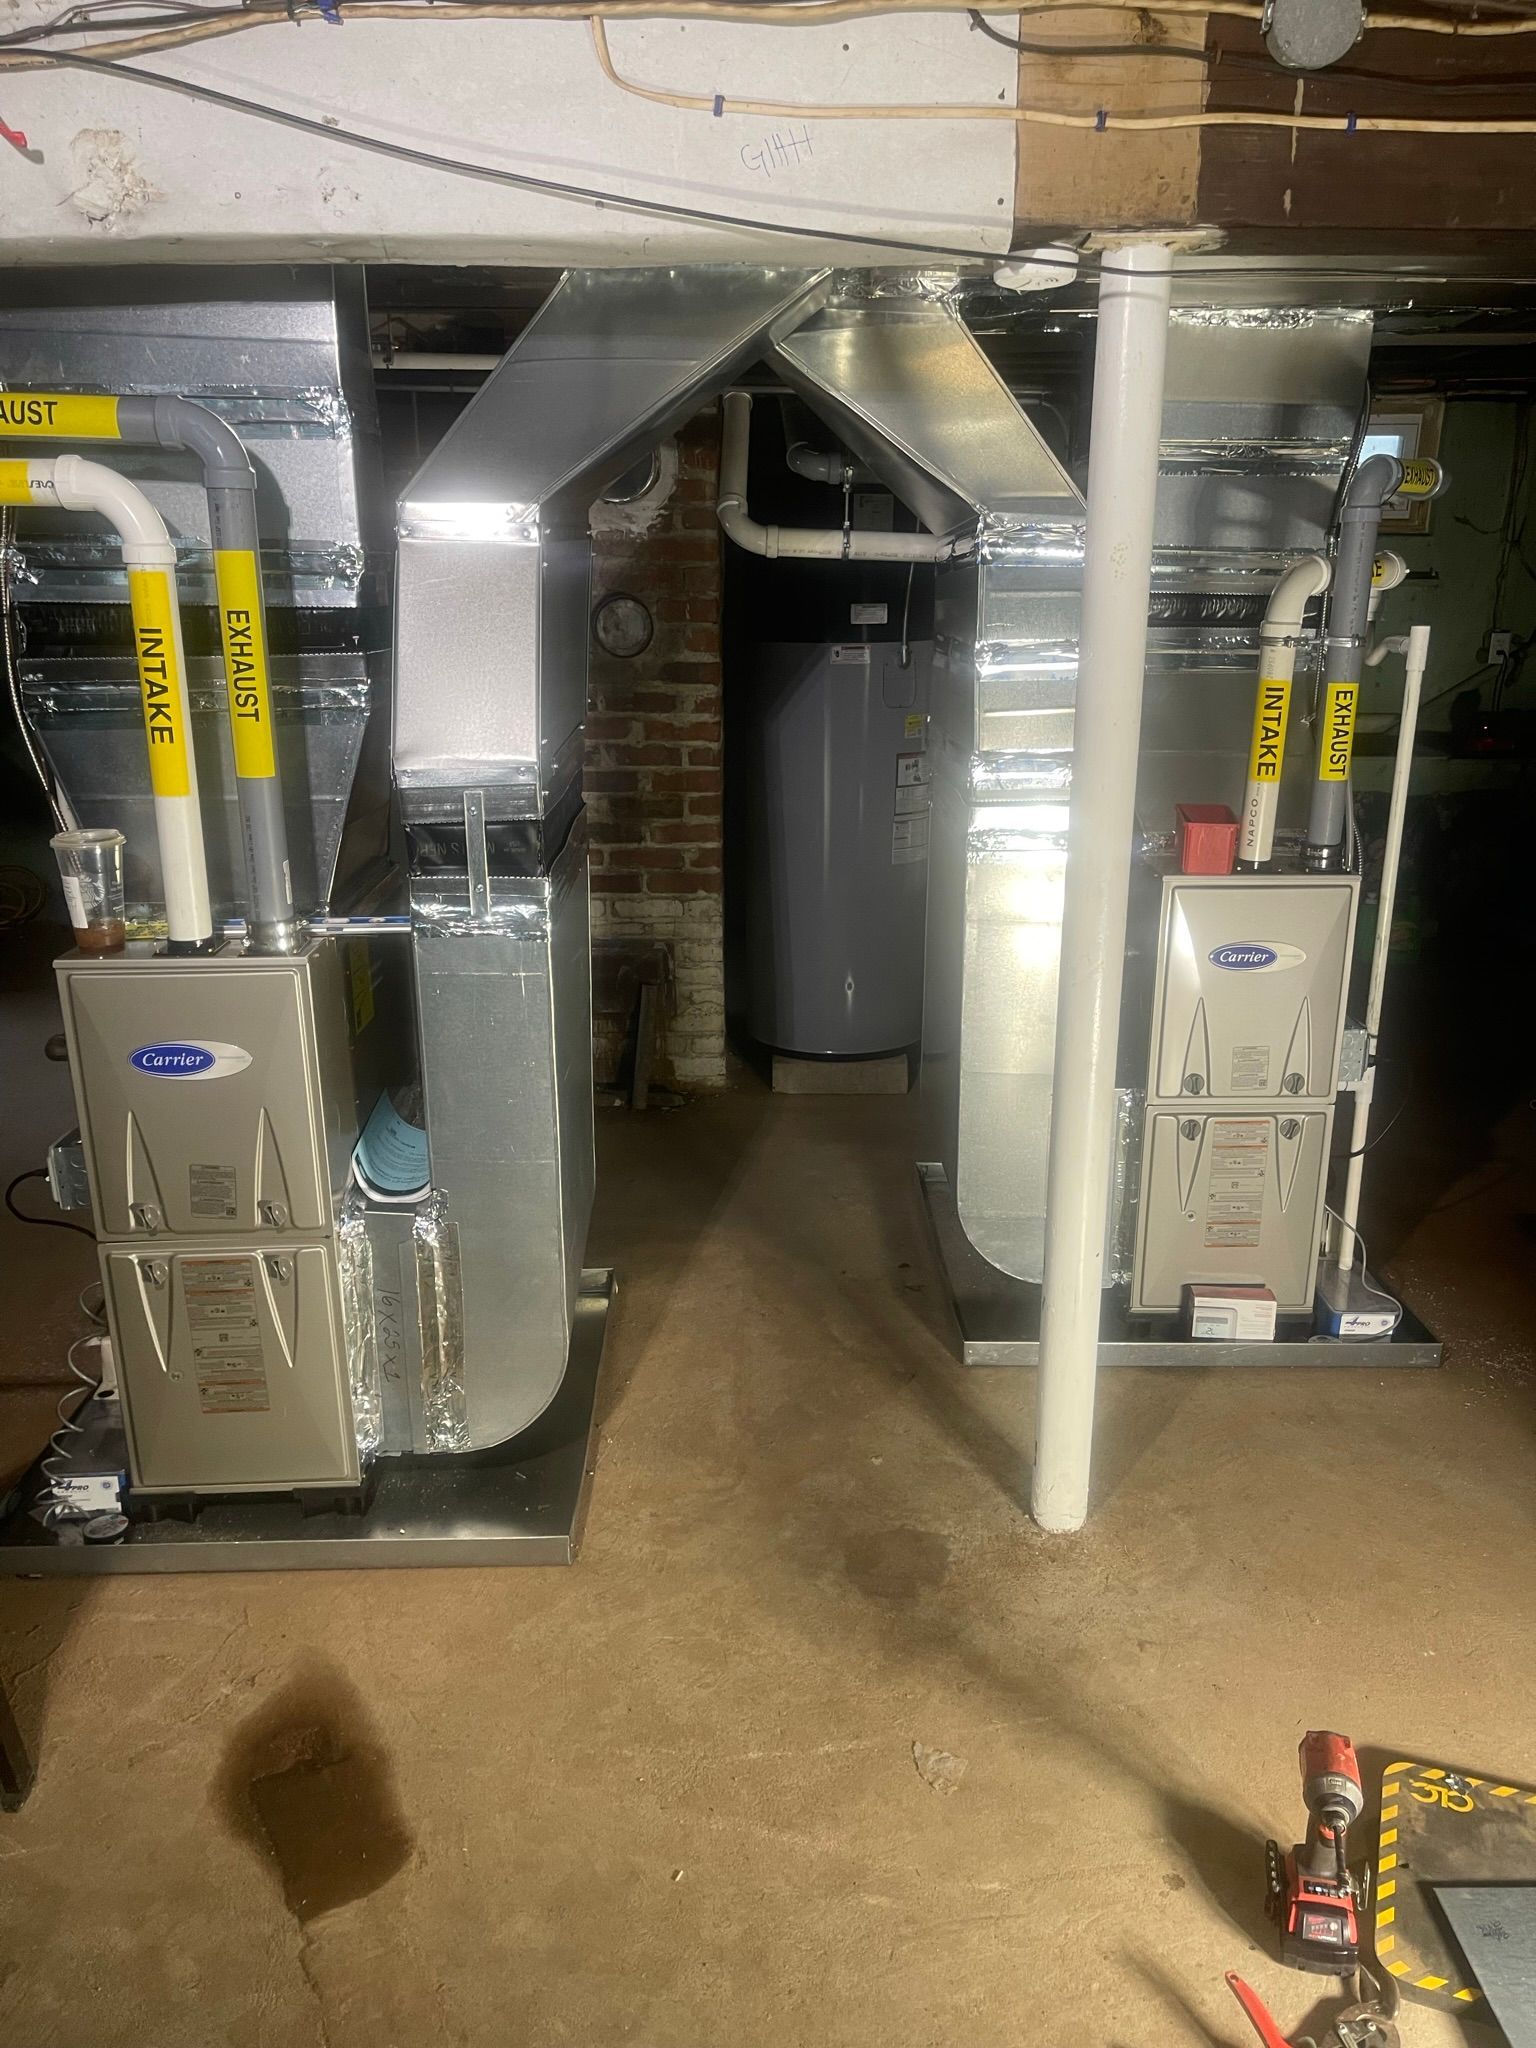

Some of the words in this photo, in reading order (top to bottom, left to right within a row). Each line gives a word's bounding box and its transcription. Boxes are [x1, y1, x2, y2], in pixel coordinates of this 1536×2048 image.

[1405, 465, 1434, 487] EXHAUST
[138, 627, 175, 745] INTAKE
[226, 610, 260, 723] EXHAUST
[1257, 687, 1285, 777] INTAKE
[1328, 689, 1354, 777] EXHAUST
[1247, 798, 1258, 847] NAPCO
[1219, 951, 1270, 963] Carrier
[142, 1052, 204, 1067] Carrier
